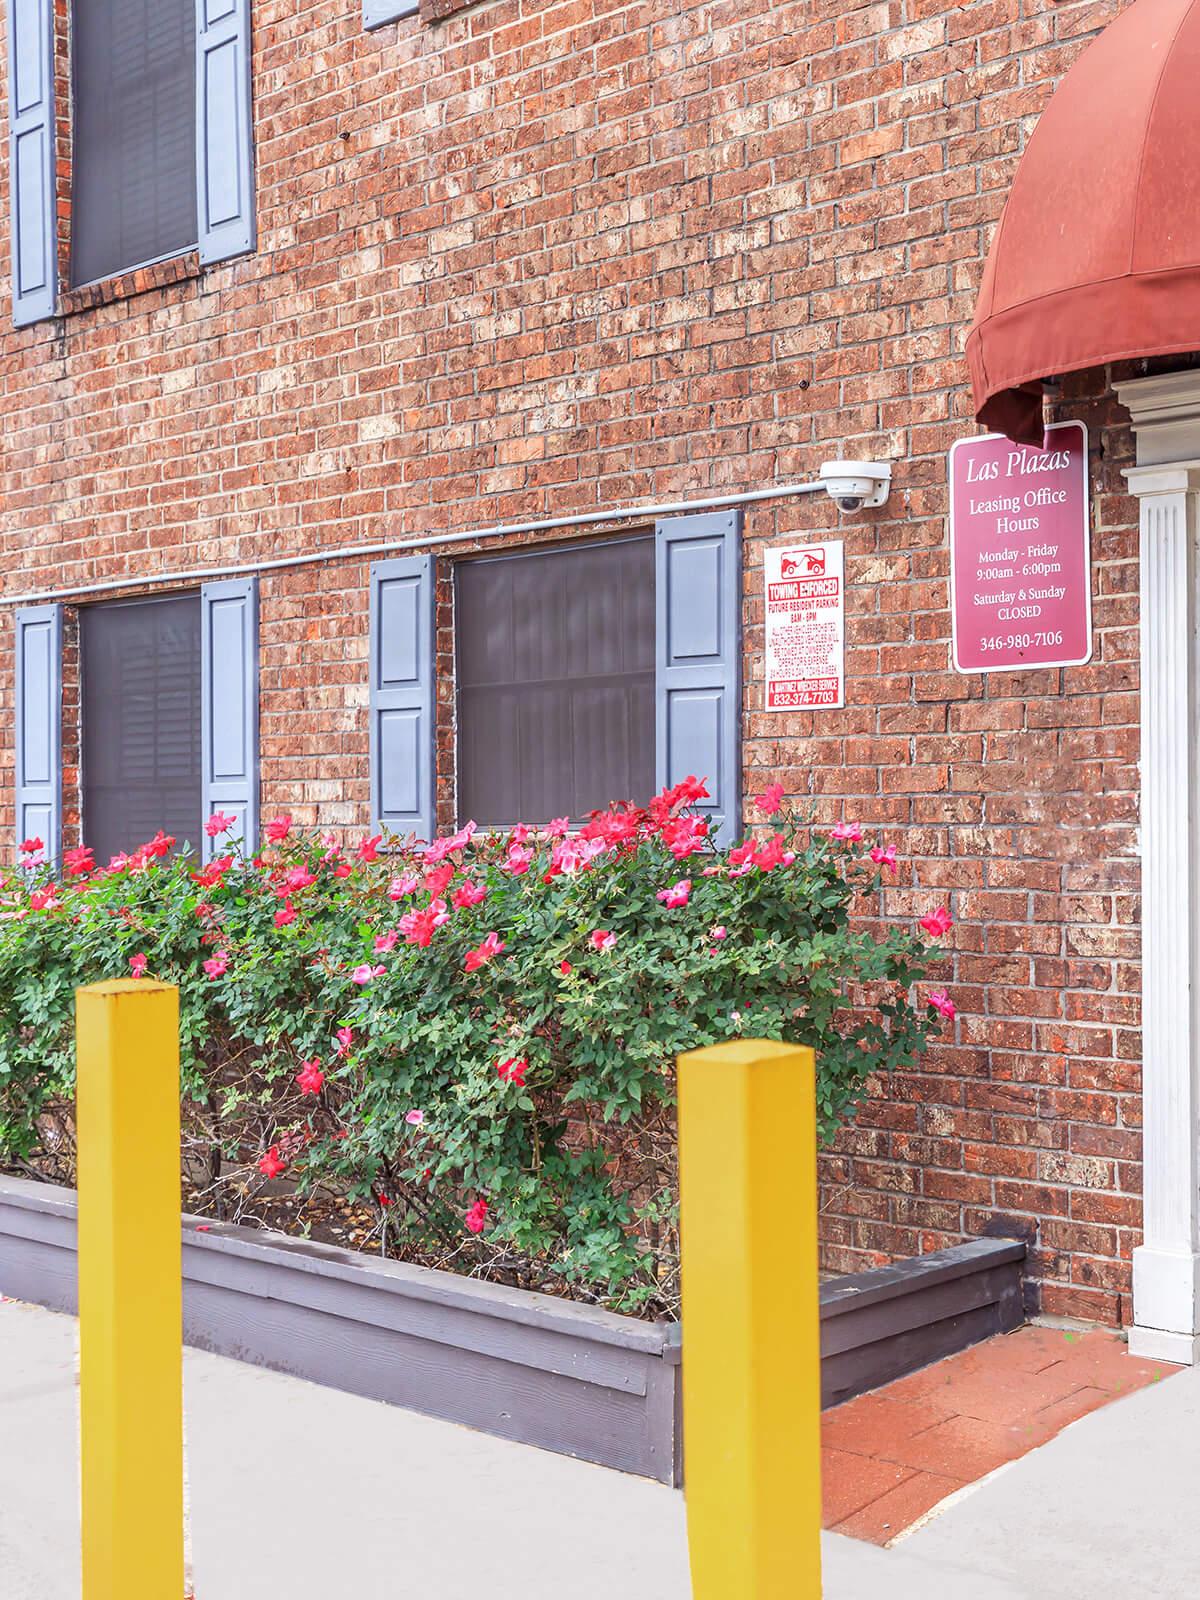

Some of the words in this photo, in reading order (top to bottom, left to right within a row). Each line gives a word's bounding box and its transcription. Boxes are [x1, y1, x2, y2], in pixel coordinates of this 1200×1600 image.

[966, 457, 998, 482] Las
[1006, 447, 1070, 476] Plazas
[969, 495, 1020, 516] Leasing
[1023, 487, 1066, 507] Office
[996, 515, 1039, 533] Hours
[979, 549, 1018, 564] Monday
[1027, 542, 1058, 560] Friday
[976, 566, 1012, 580] 9:00am
[1022, 560, 1060, 578] 6:00pm
[770, 583, 797, 599] TOWING
[800, 579, 837, 596] ENFORCED
[974, 591, 1016, 606] Saturday
[1018, 588, 1026, 601] &
[1028, 584, 1065, 602] Sunday
[768, 602, 788, 613] FUTURE
[790, 600, 814, 611] RESIDENT
[815, 597, 838, 609] PARKING
[998, 604, 1041, 620] CLOSED
[980, 631, 1062, 651] 346-980-7106
[818, 678, 837, 691] SERVICE
[773, 692, 833, 704] 832-374-7703
